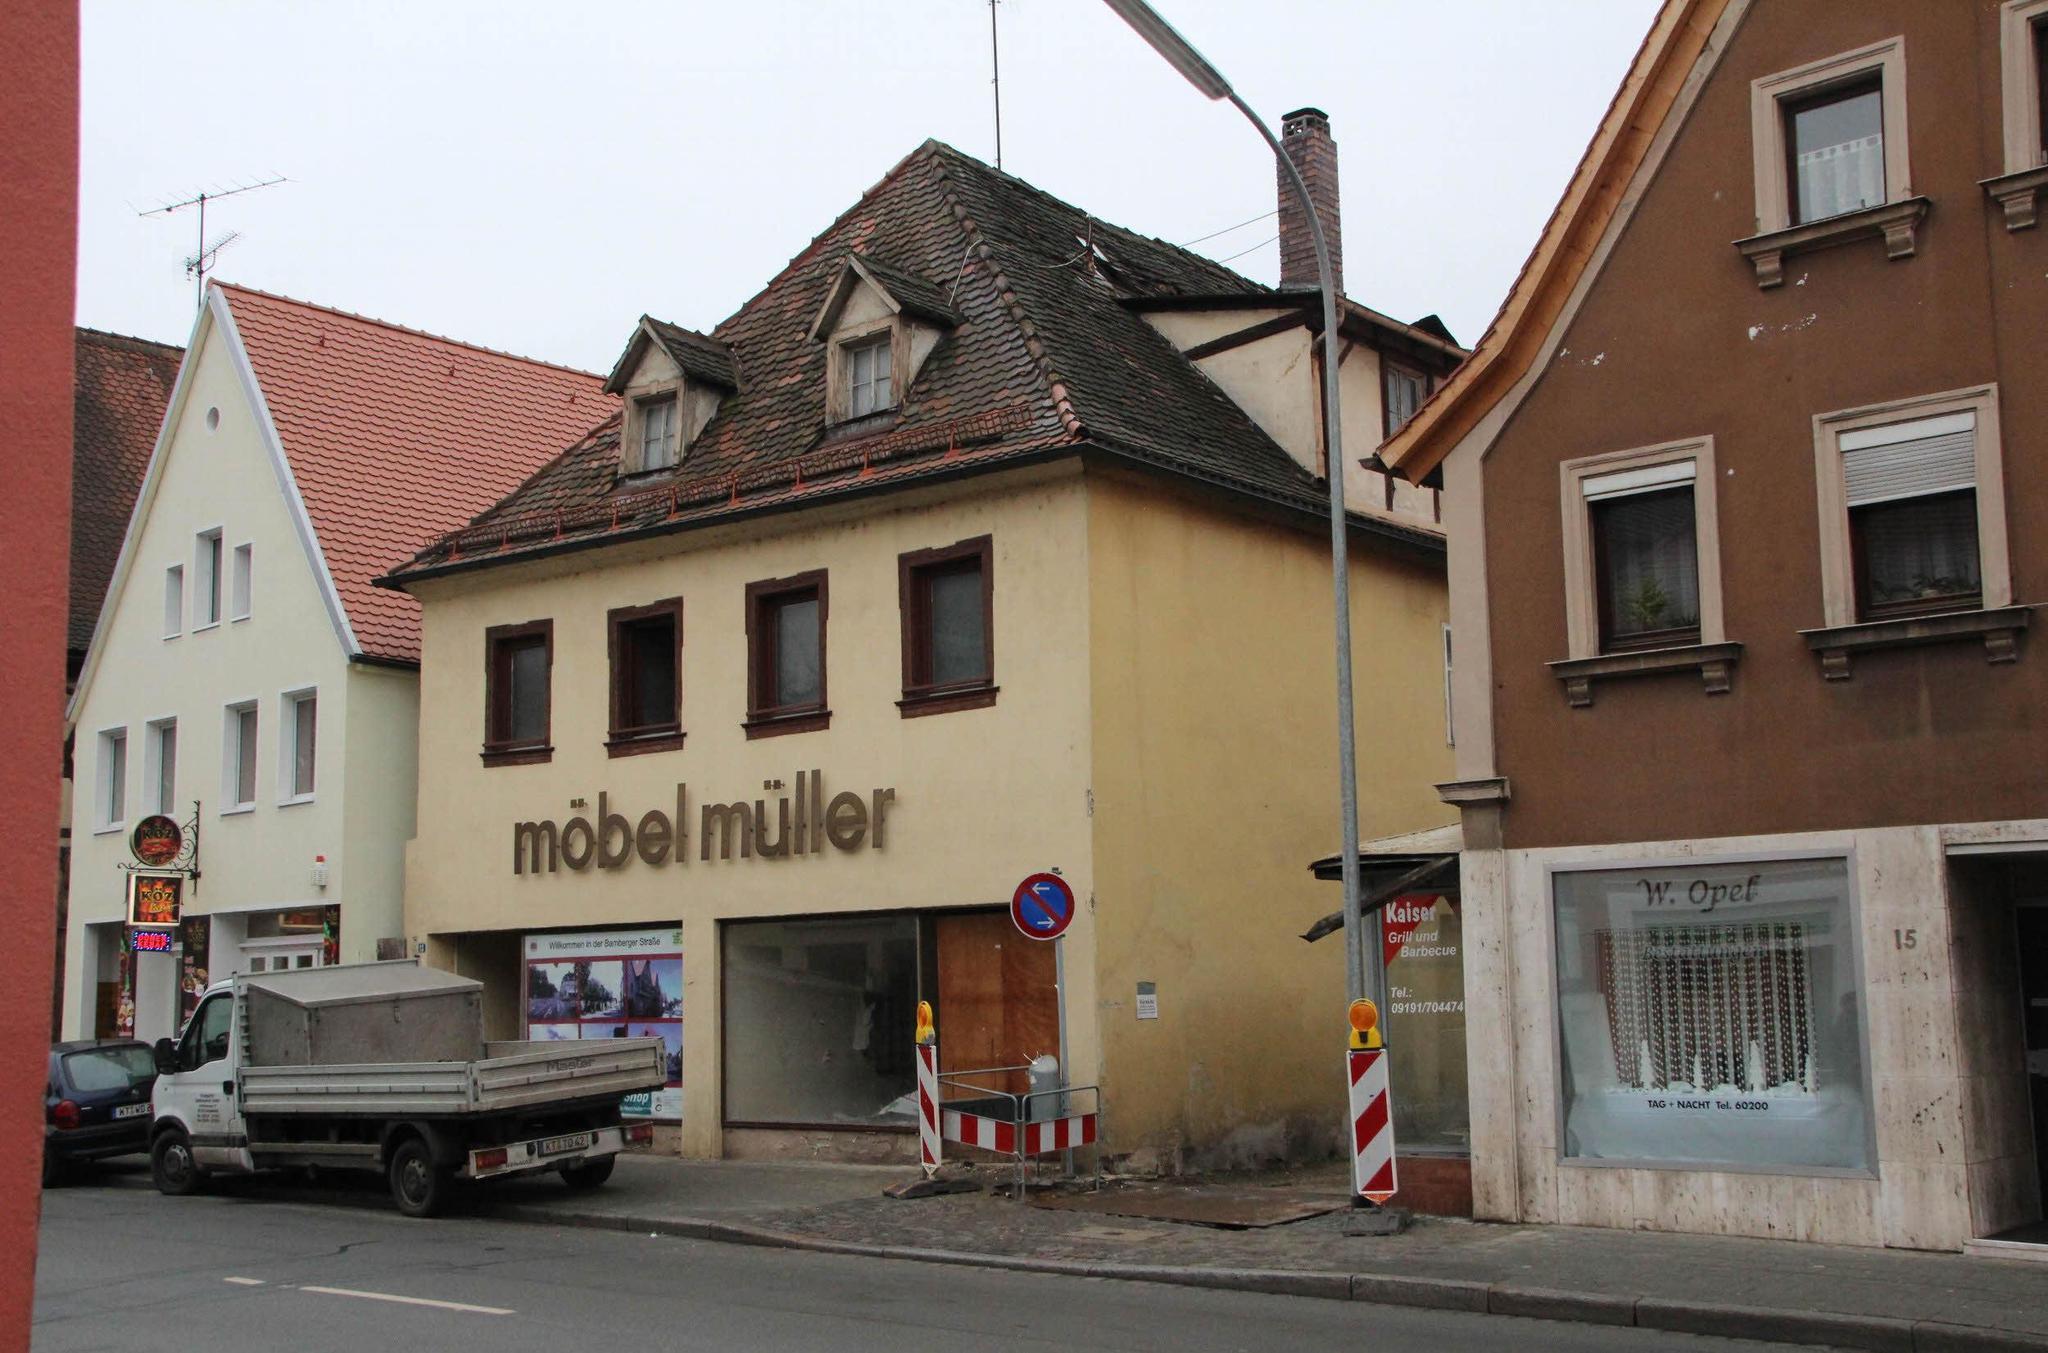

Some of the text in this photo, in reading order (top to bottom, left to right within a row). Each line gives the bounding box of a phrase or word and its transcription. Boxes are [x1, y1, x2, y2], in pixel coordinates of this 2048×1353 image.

[514, 769, 895, 874] möbel müller
[141, 887, 173, 902] KÖZ
[1637, 874, 1762, 913] W. Opel
[1385, 901, 1437, 924] Kaiser
[549, 940, 585, 950] Willkommen
[586, 939, 592, 948] in
[592, 938, 603, 948] der
[604, 937, 638, 949] Bamberger
[640, 936, 661, 946] Straße
[1388, 930, 1439, 944] Grill und
[1894, 928, 1917, 950] 15
[1400, 945, 1457, 958] Barbecue
[1391, 987, 1413, 999] Tel.:
[1391, 1001, 1464, 1014] 09191/704474
[1647, 1100, 1666, 1109] TAG
[1677, 1100, 1711, 1110] NACHT
[1715, 1101, 1732, 1110] Tel.
[1735, 1101, 1769, 1111] 60200
